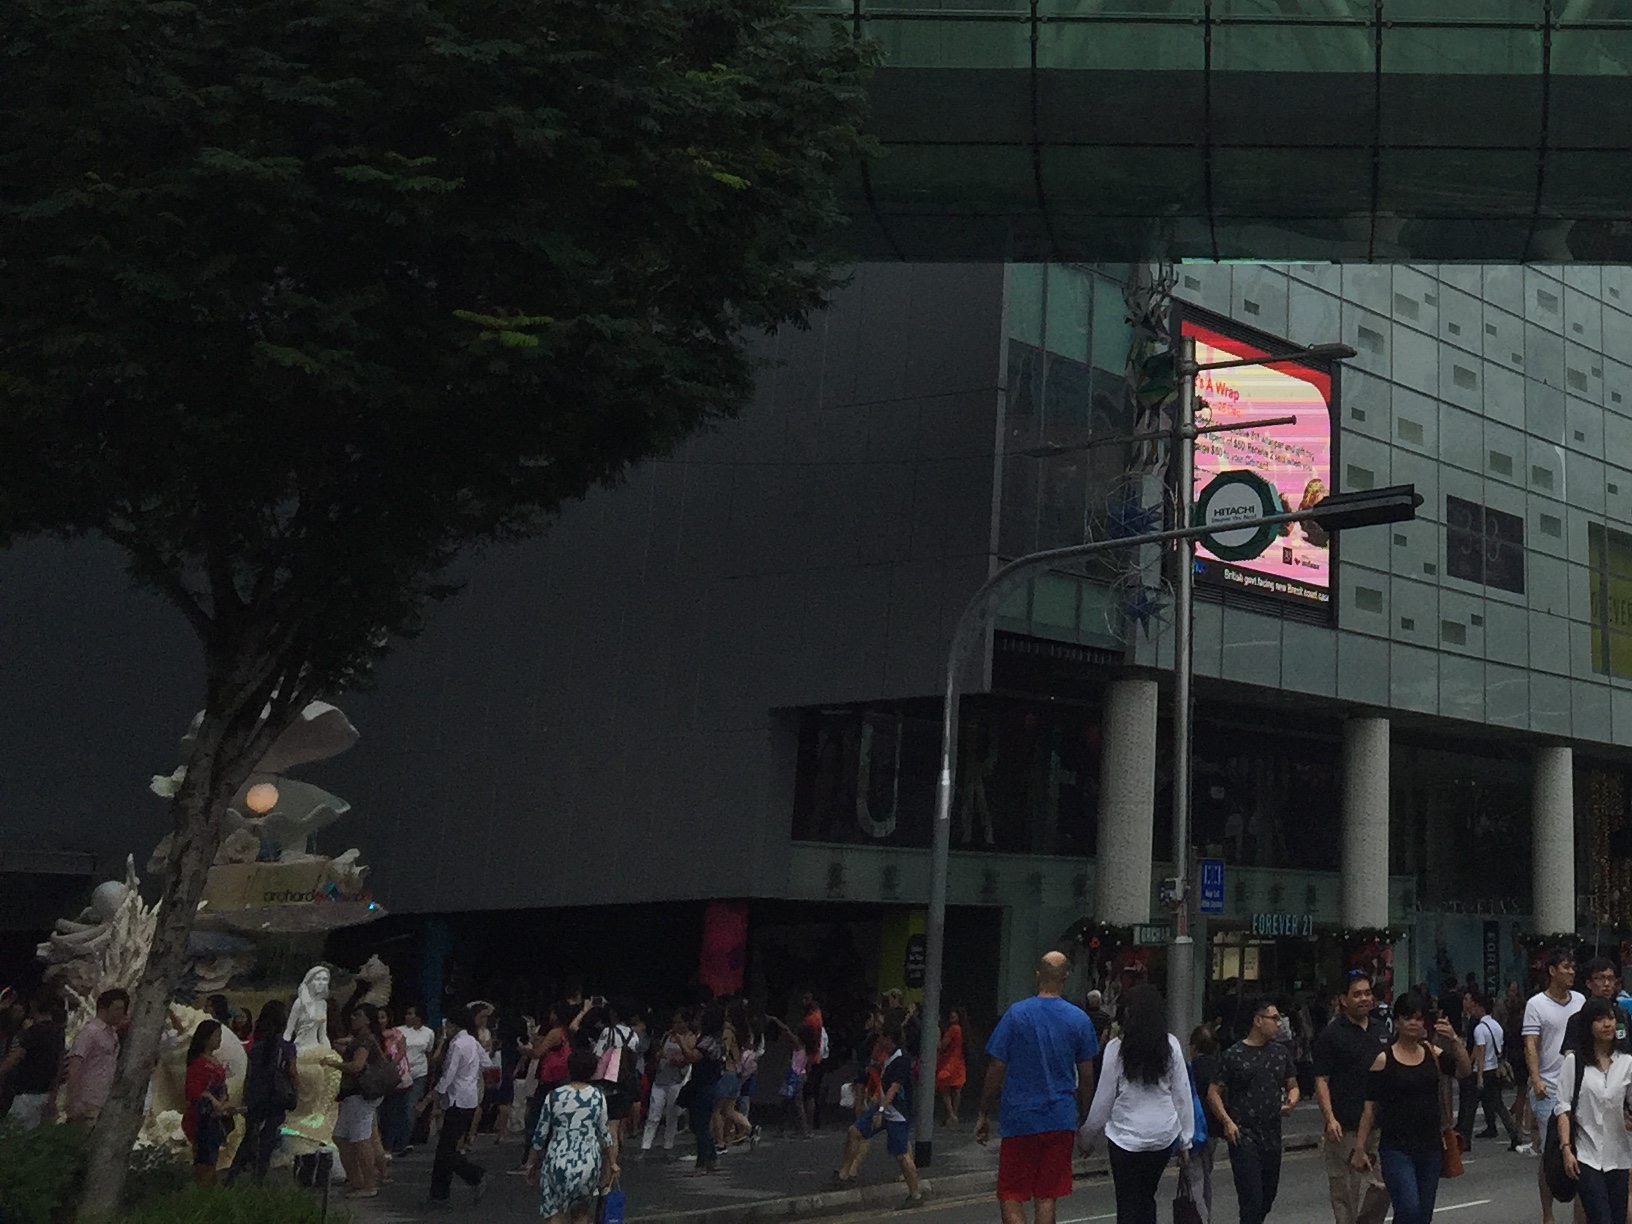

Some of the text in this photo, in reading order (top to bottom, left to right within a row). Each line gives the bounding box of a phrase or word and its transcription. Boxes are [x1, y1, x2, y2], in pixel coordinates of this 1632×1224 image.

[1216, 381, 1240, 403] Wrap
[1213, 505, 1255, 517] HITACHI
[1253, 913, 1313, 937] FOREVER 21
